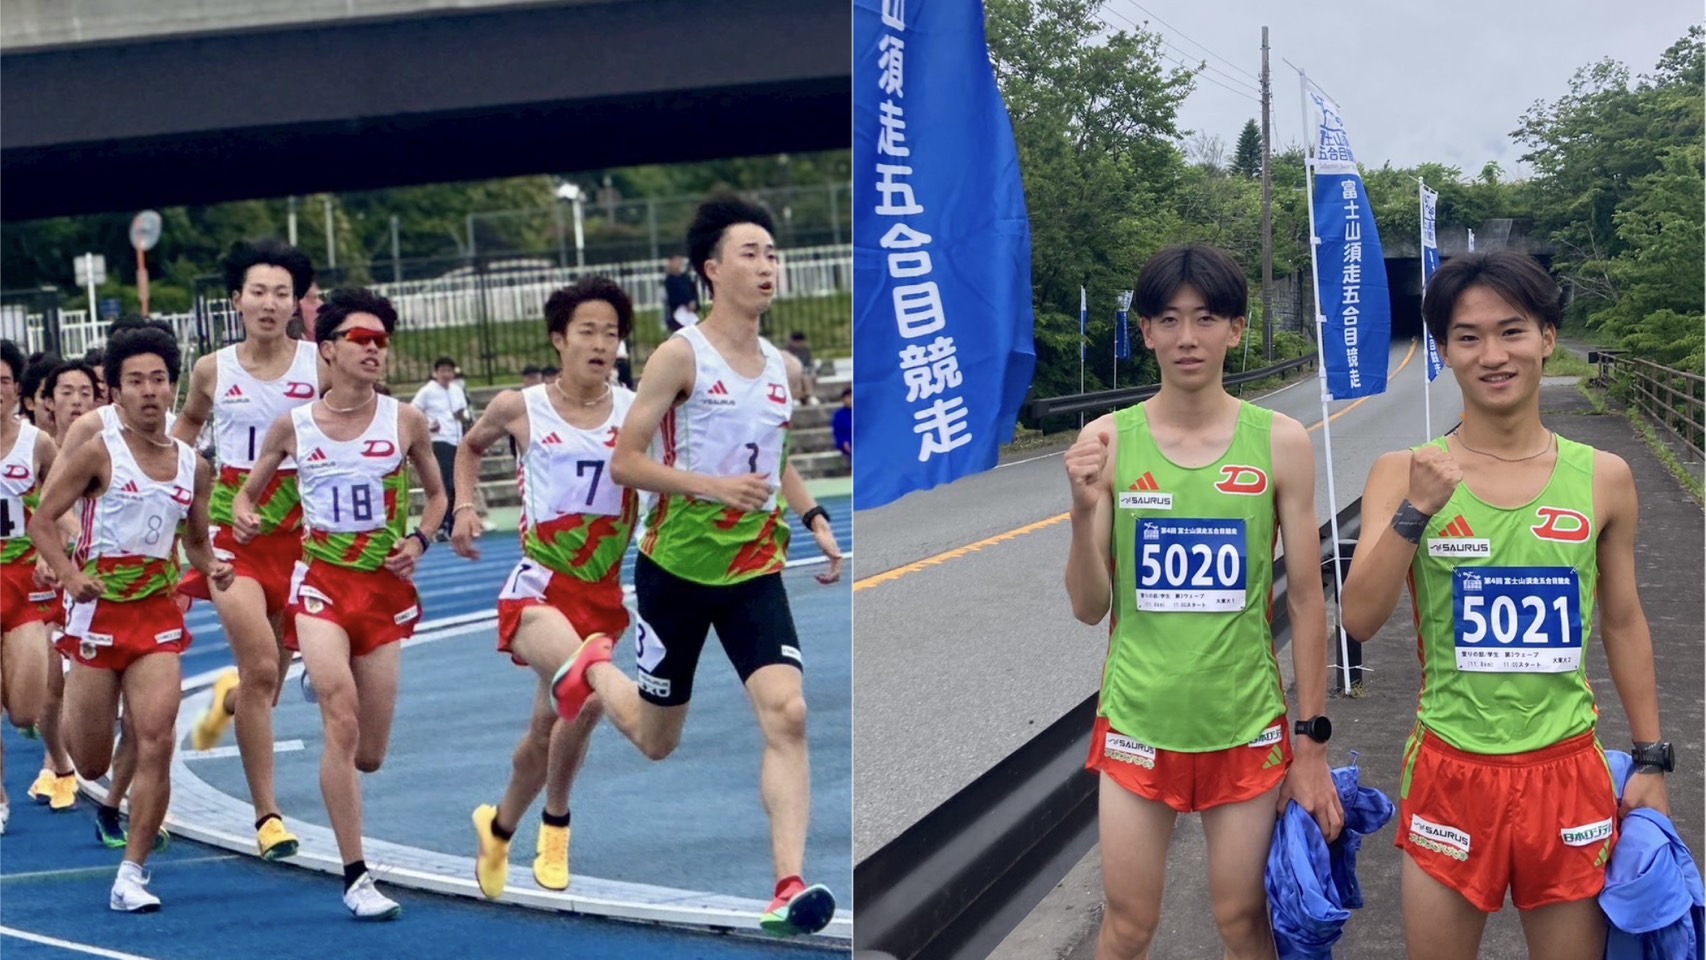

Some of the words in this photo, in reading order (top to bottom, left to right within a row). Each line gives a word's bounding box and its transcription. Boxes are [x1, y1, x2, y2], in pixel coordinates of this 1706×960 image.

[1341, 179, 1362, 388] 富士山須走五合目競走
[576, 460, 605, 506] 7
[1131, 496, 1171, 505] SAURUS
[332, 484, 372, 523] 18
[145, 514, 162, 545] 8
[1442, 543, 1489, 552] SAURUS
[1141, 543, 1240, 587] 5020
[1462, 595, 1571, 644] 5021
[1425, 826, 1468, 846] SAURUS
